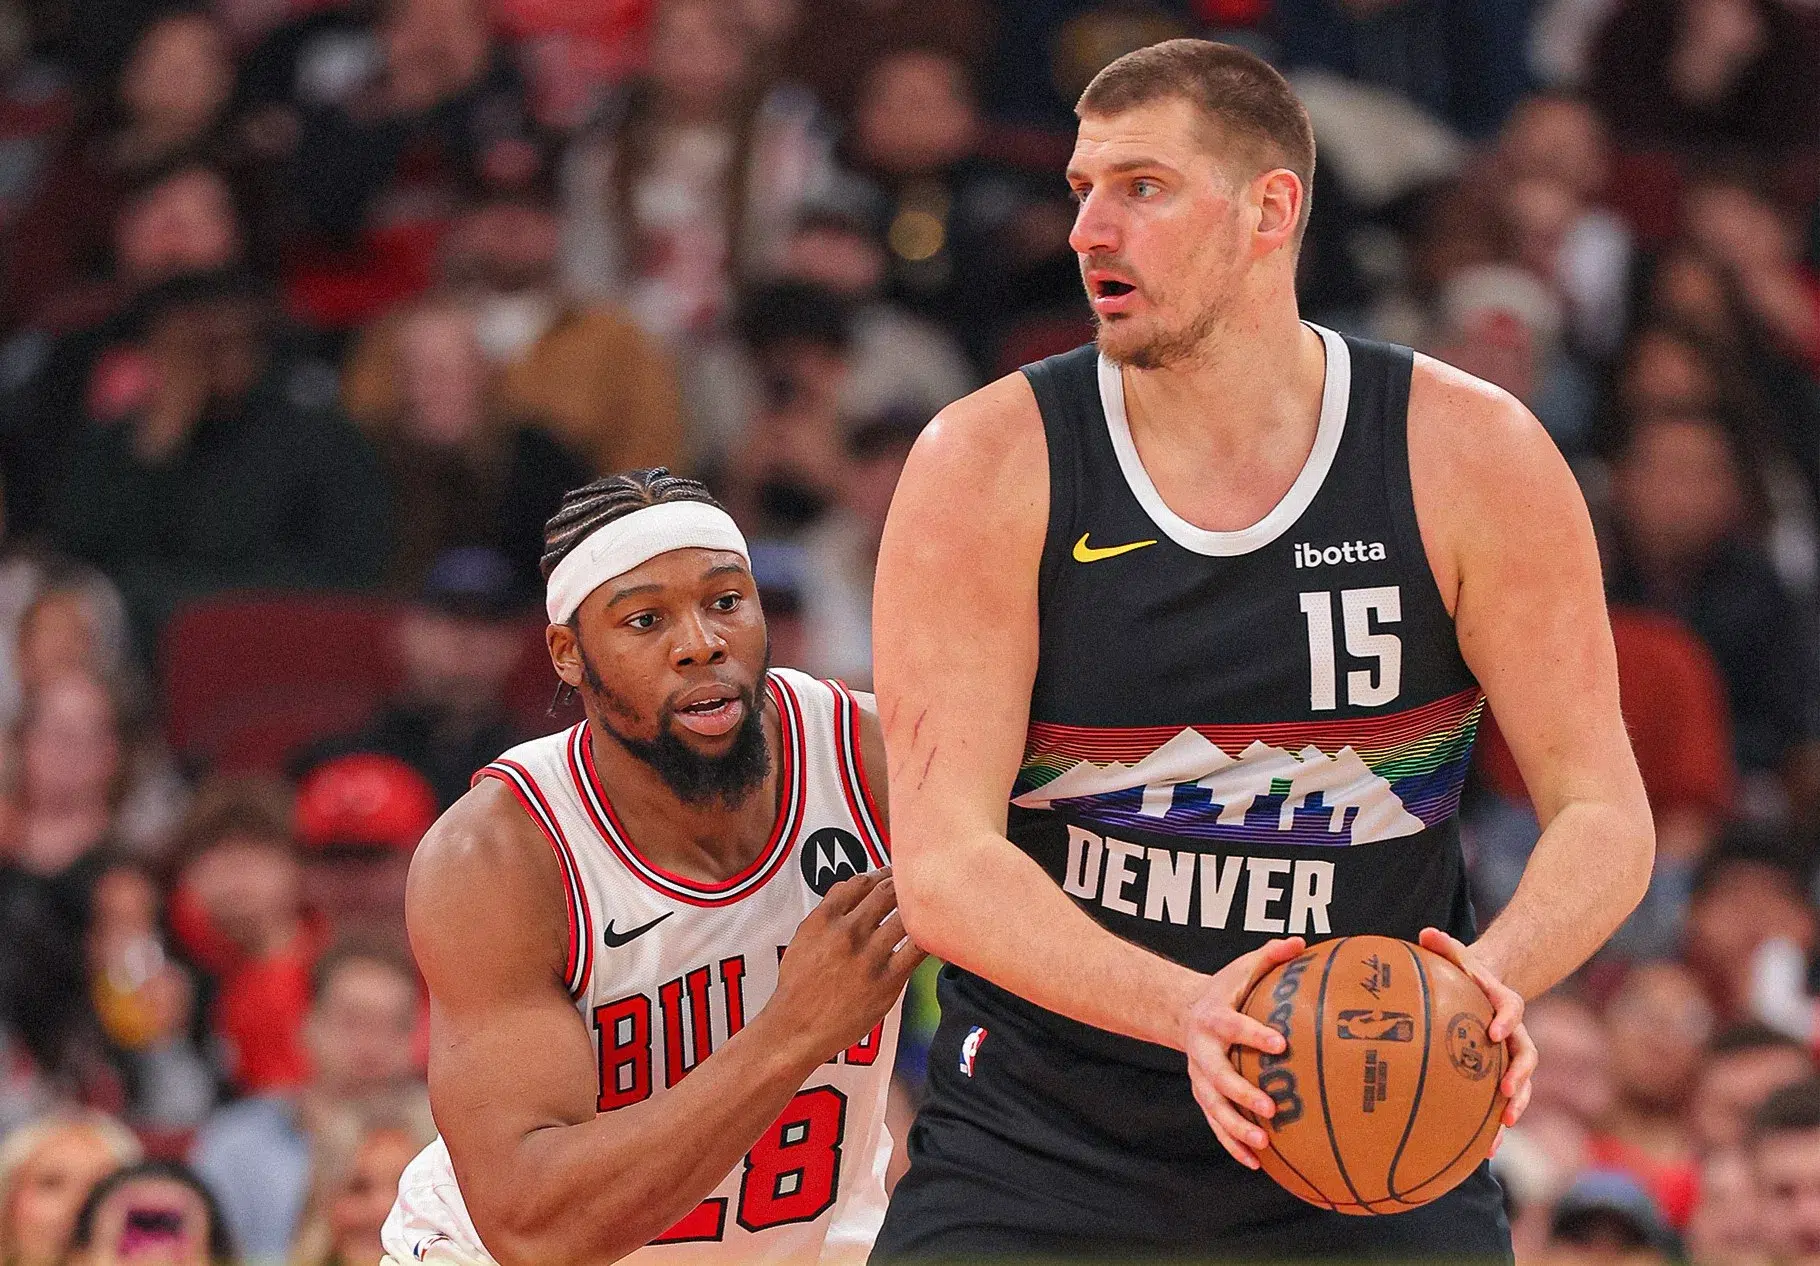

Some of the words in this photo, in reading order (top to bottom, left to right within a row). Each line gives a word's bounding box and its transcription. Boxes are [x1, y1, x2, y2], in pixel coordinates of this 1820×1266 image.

[1294, 540, 1387, 569] ibotta
[1299, 585, 1402, 711] 15
[1063, 824, 1335, 934] DENVER
